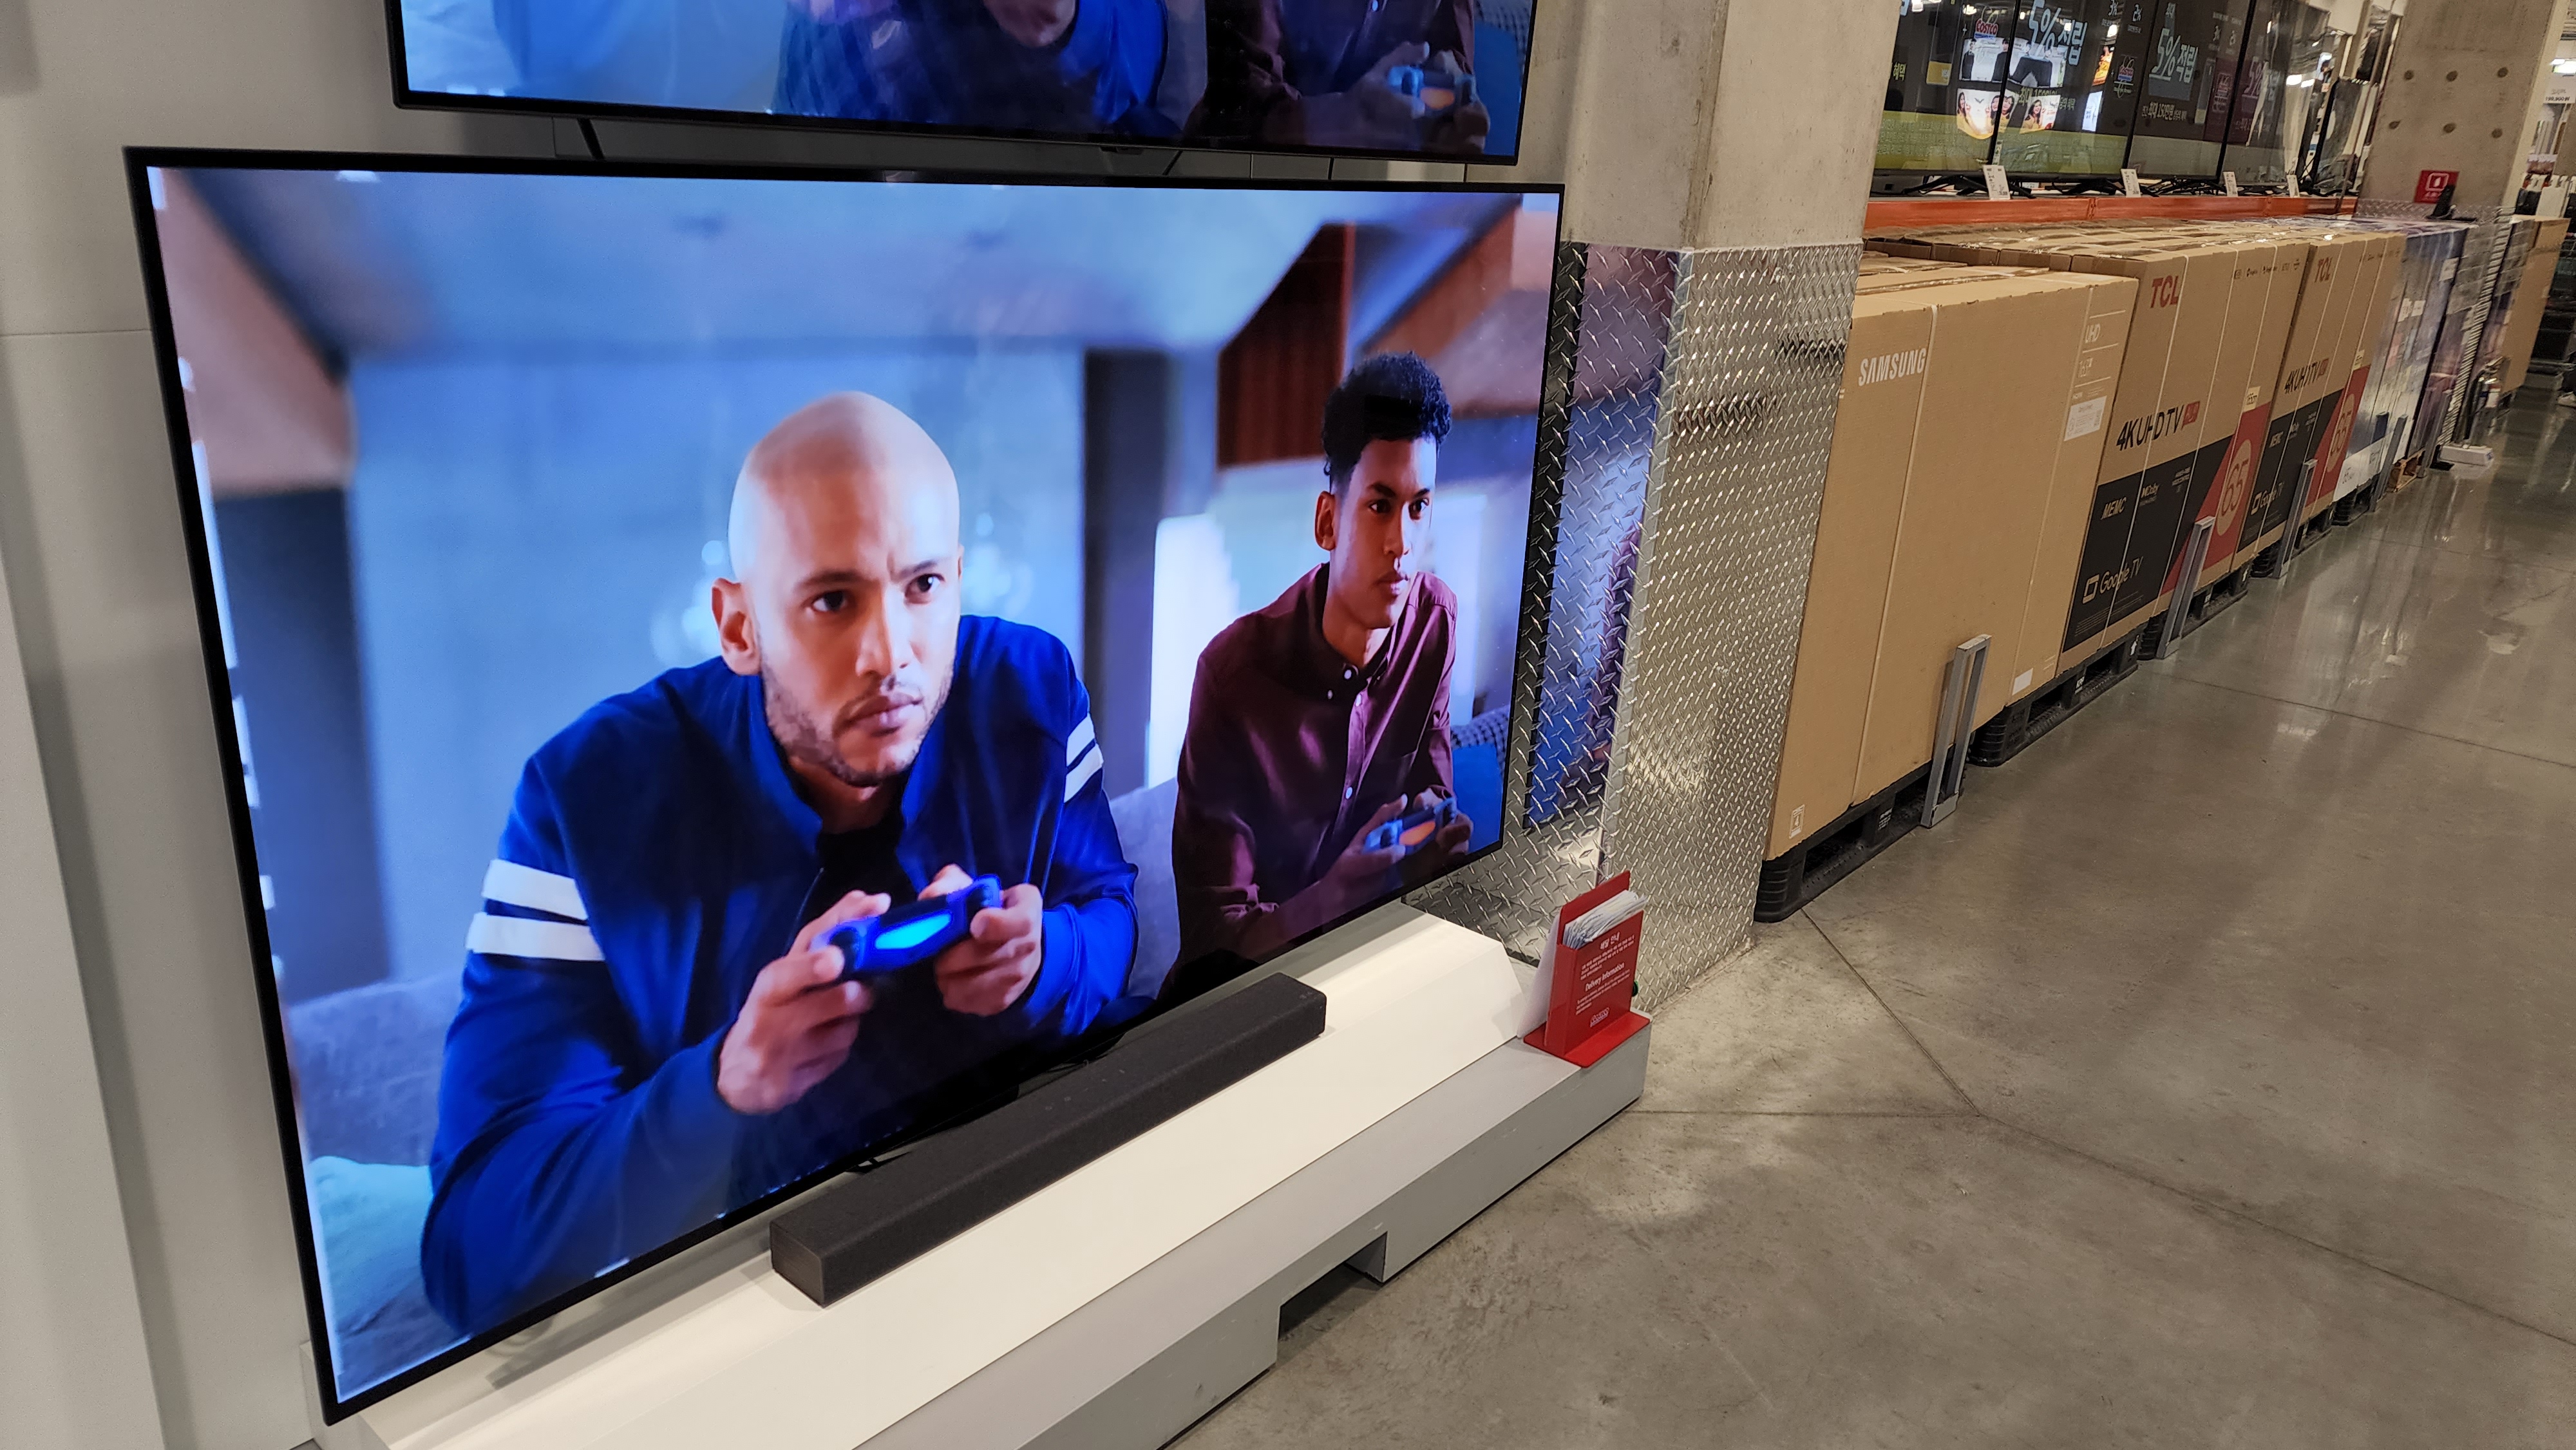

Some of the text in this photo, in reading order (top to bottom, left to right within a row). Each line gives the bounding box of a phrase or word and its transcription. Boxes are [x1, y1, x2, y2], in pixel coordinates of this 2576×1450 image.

[1976, 19, 1998, 35] COSTCO
[2151, 28, 2181, 77] 5%
[2176, 44, 2199, 84] 적립
[2148, 101, 2159, 119] 최대
[2315, 257, 2333, 283] TCL
[2150, 276, 2180, 308] TCL
[2085, 323, 2101, 343] UHD
[1858, 348, 1927, 386] SAMSUNG
[2330, 410, 2352, 457] 65
[2222, 458, 2249, 516] 65
[2101, 496, 2127, 520] MEMC
[2099, 556, 2144, 594] Google TV
[1585, 961, 1625, 992] Delivery Information
